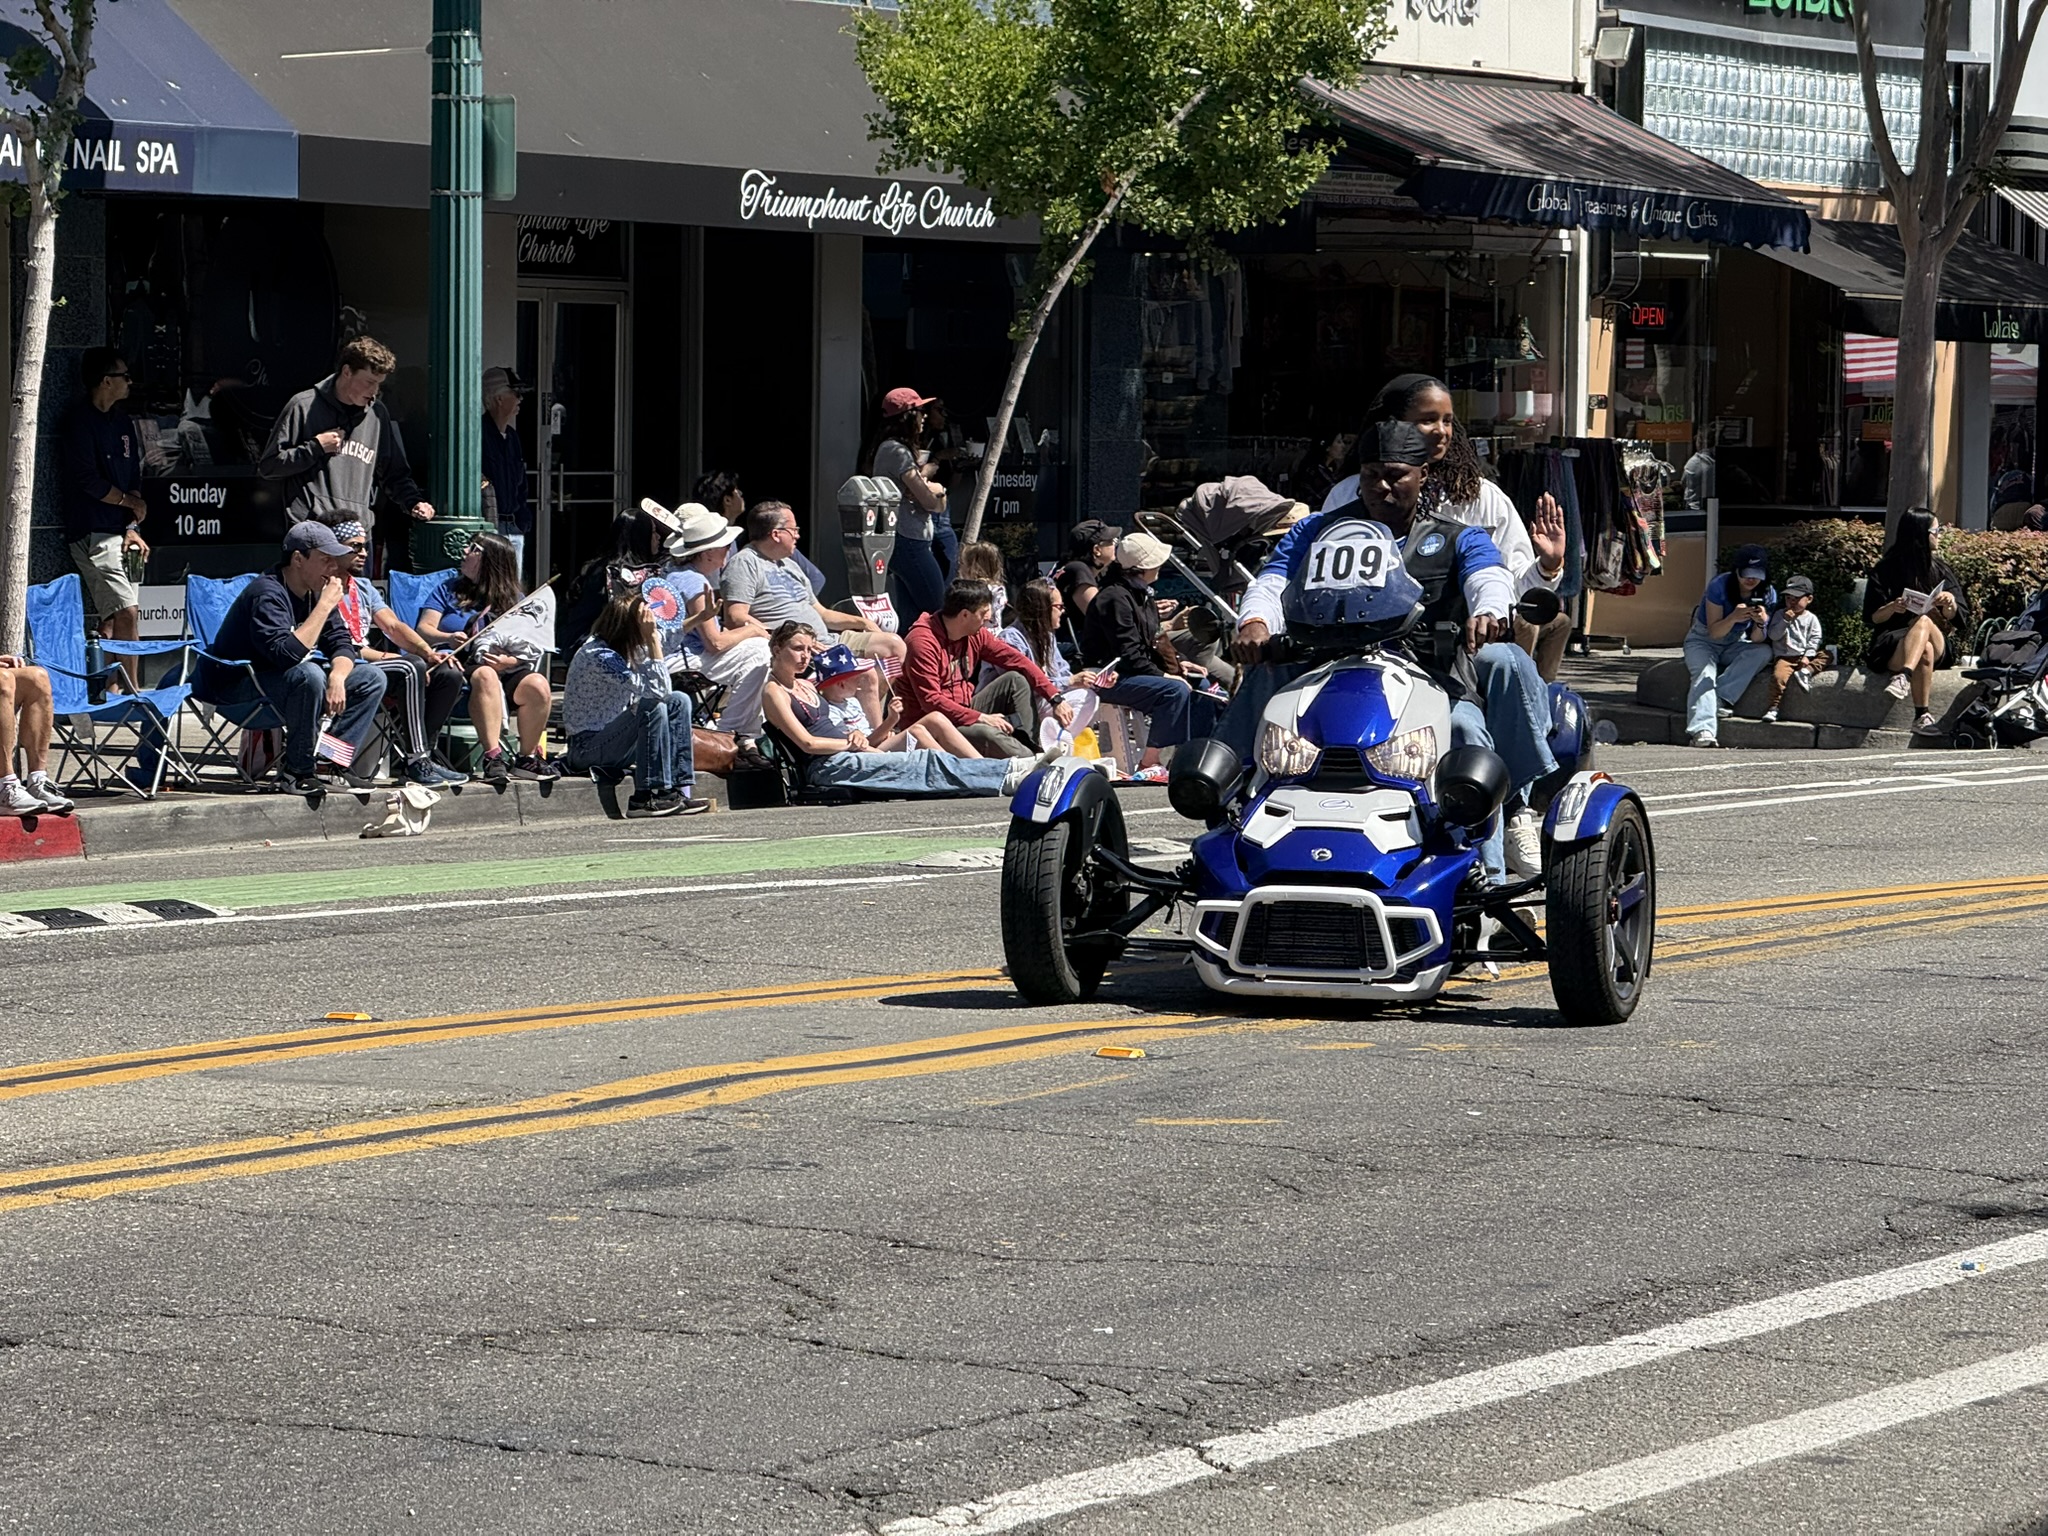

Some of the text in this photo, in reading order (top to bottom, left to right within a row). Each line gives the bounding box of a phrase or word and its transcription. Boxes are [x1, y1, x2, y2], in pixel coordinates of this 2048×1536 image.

[73, 138, 125, 171] NAIL
[136, 140, 179, 174] SPA
[740, 169, 996, 235] Triumphant Life Church
[1527, 183, 1718, 233] Global Treasures & Unique Gifts
[518, 232, 577, 264] Church
[1632, 306, 1665, 325] OPEN
[1983, 309, 2020, 339] Lola's
[169, 482, 227, 508] Sunday
[975, 470, 1038, 492] dnesday
[993, 496, 1020, 518] 7 pm
[175, 514, 221, 536] 10 am
[1311, 545, 1383, 583] 109
